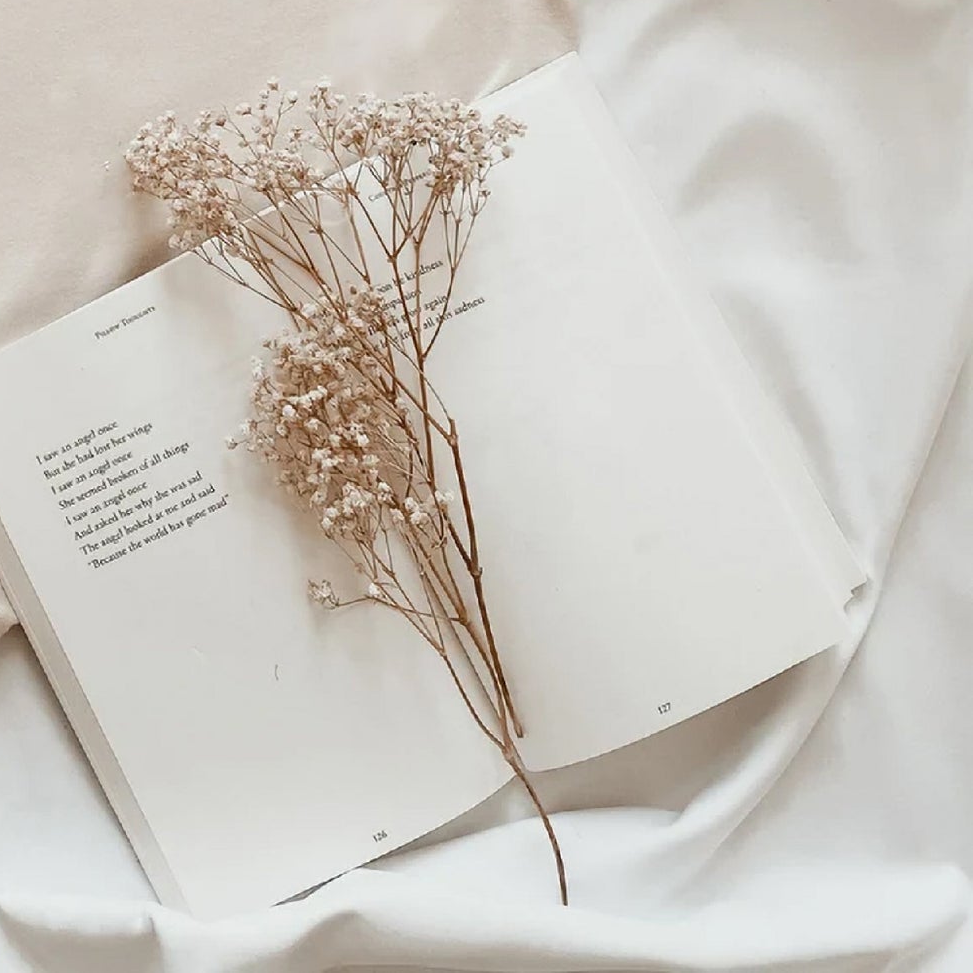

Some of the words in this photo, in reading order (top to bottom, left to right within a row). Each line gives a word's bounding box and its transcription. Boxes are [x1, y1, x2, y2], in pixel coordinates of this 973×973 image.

[405, 259, 443, 280] kidness
[423, 317, 435, 330] all
[74, 430, 96, 447] angel
[98, 422, 118, 435] once
[75, 450, 94, 464] had
[110, 436, 126, 447] her
[127, 423, 152, 439] wings
[59, 498, 75, 510] She
[76, 481, 107, 501] seemed
[106, 469, 138, 486] broken
[139, 459, 149, 470] of
[150, 454, 161, 466] all
[163, 443, 189, 459] things
[75, 525, 94, 540] And
[94, 513, 119, 531] asked
[118, 508, 134, 518] her
[135, 497, 152, 510] why
[187, 470, 203, 485] sad
[79, 543, 100, 555] The
[100, 528, 123, 546] angel
[123, 514, 154, 534] looked
[198, 484, 215, 498] said
[102, 490, 126, 508] angel
[128, 541, 142, 552] the
[143, 525, 169, 544] world
[168, 521, 184, 532] has
[186, 509, 207, 527] gone
